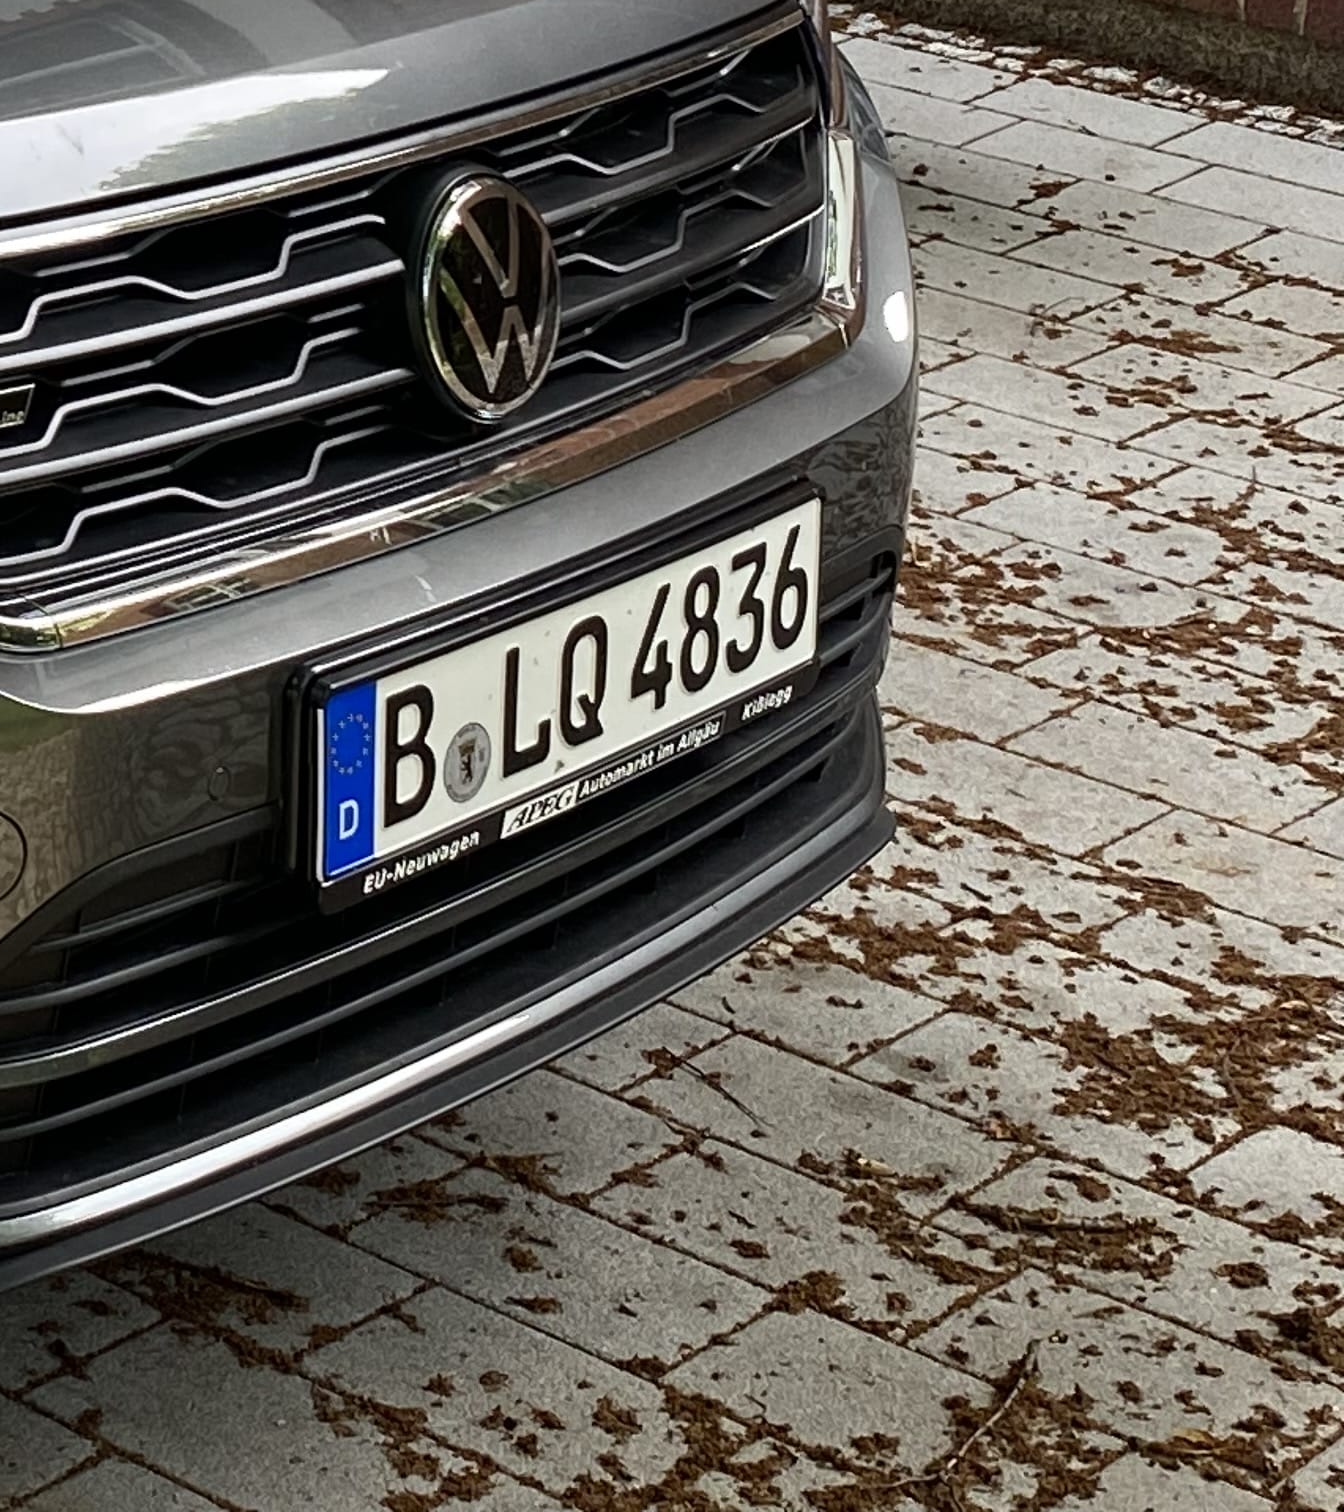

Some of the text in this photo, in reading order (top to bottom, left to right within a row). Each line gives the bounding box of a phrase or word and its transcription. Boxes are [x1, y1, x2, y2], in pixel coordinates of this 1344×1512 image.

[384, 684, 436, 828] B
[502, 615, 608, 777] LQ
[630, 524, 809, 711] 4836
[339, 799, 359, 840] D
[363, 831, 480, 895] EU-Neuwagen
[579, 750, 654, 799] Automarkt
[656, 742, 675, 761] im
[677, 721, 720, 753] Allgäu
